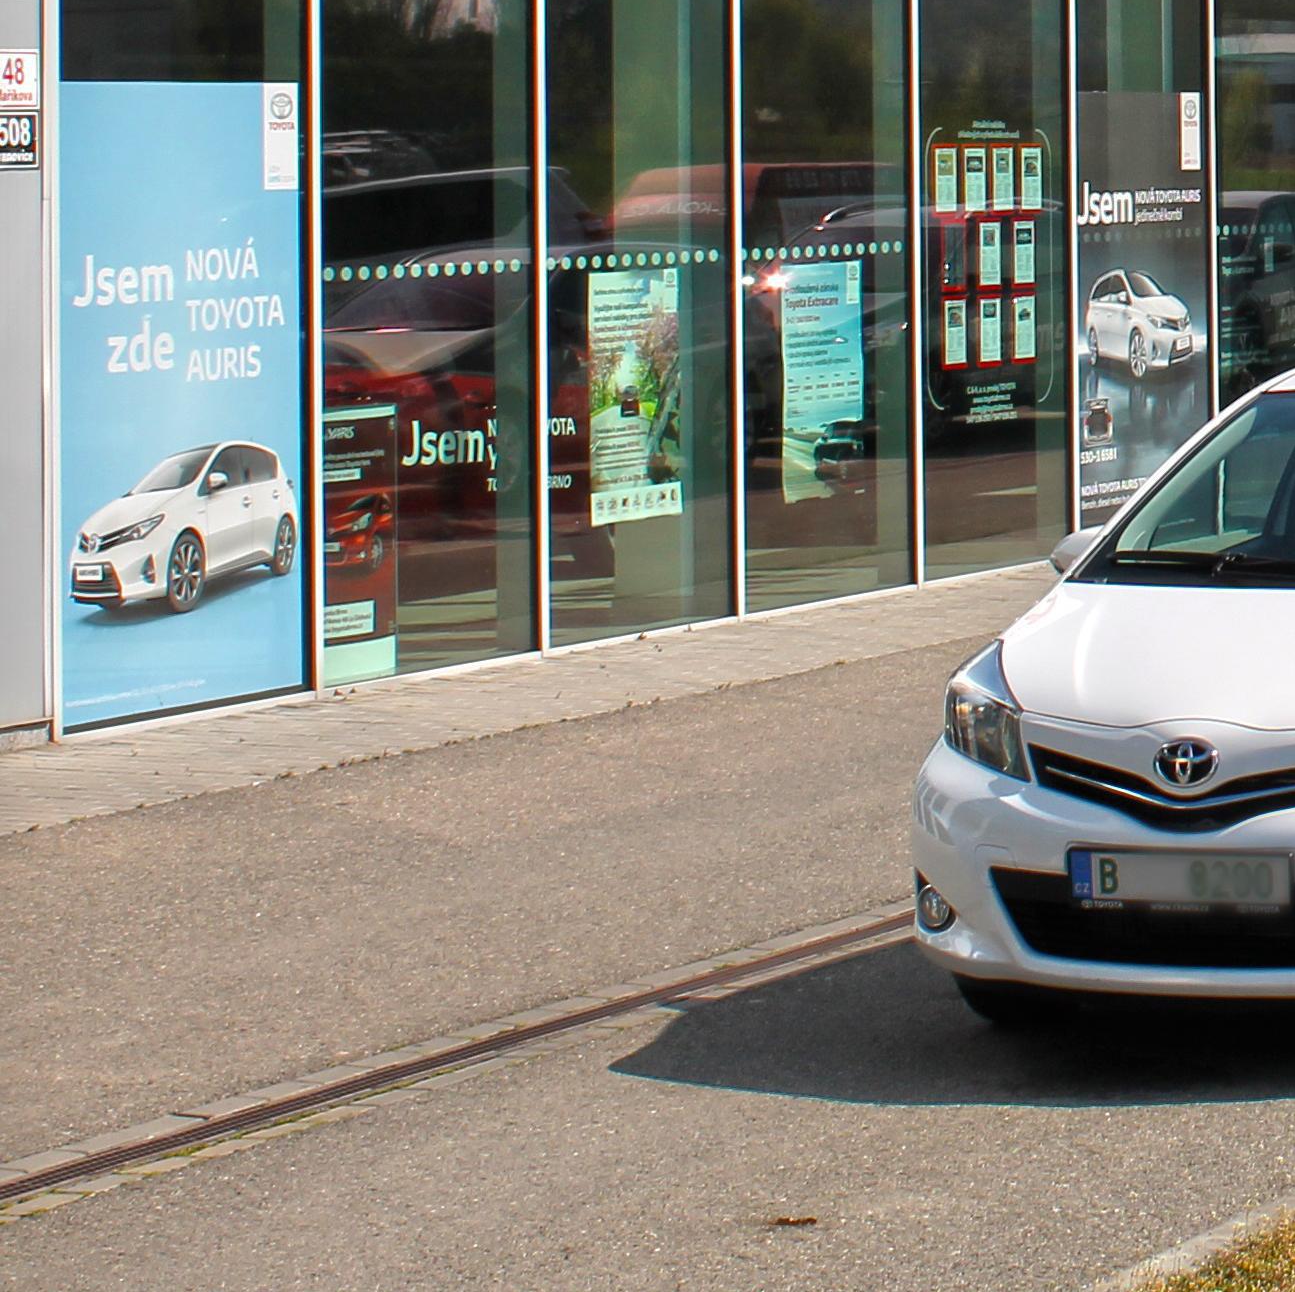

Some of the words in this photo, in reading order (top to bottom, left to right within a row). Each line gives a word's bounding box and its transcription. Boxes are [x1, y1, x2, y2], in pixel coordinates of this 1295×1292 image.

[2, 57, 25, 86] 48
[268, 121, 296, 131] TOYOTA
[1077, 181, 1134, 226] Jsem
[1135, 187, 1155, 204] NOVÁ
[1156, 189, 1181, 204] TOYOTA
[1182, 188, 1201, 203] AURIS
[186, 236, 260, 281] NOVÁ
[73, 254, 174, 308] Jsem
[186, 294, 285, 332] TOYOTA
[107, 318, 175, 374] zde
[186, 345, 261, 383] AURIS
[401, 419, 485, 467] Jsem
[1074, 882, 1091, 894] CZ
[1100, 858, 1118, 894] B
[1094, 900, 1124, 909] TOYOTA
